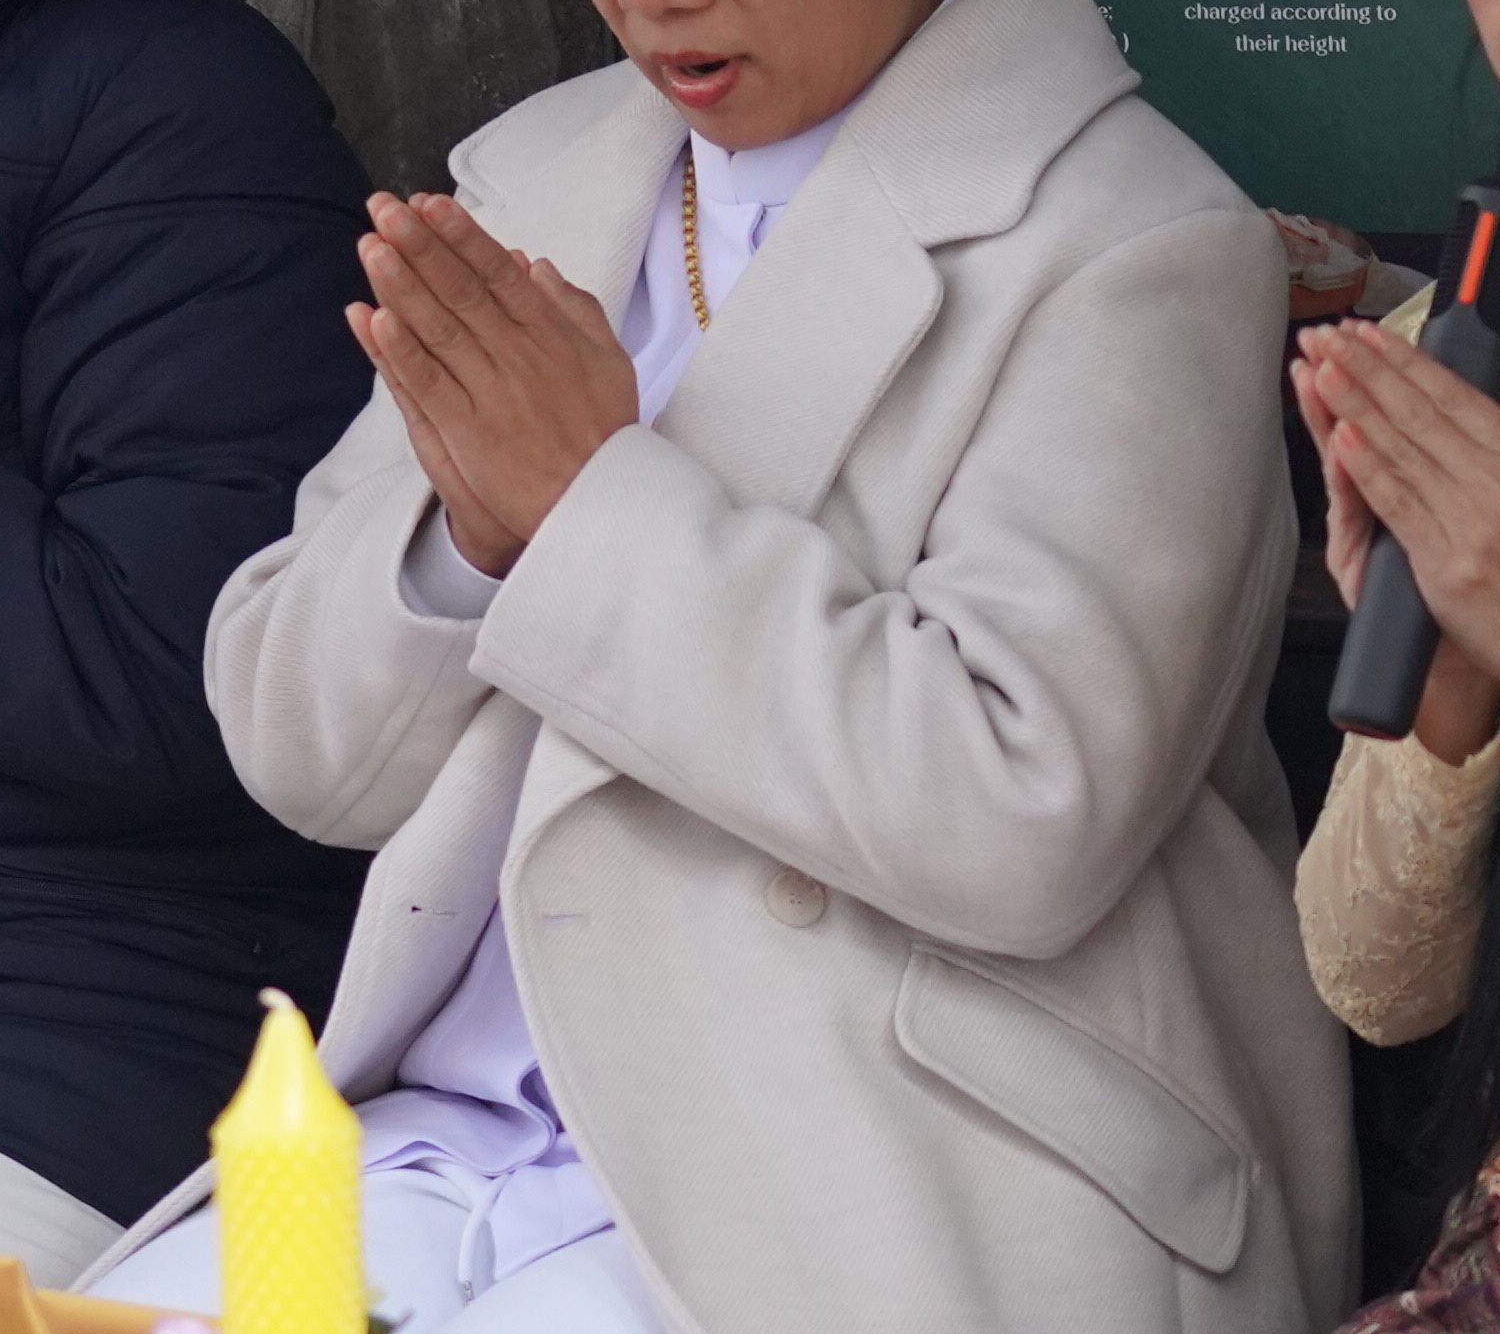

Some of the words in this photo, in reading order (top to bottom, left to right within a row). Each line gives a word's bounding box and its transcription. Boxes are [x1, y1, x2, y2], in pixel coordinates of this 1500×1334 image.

[1184, 2, 1265, 24] charged
[1270, 3, 1371, 25] according
[1376, 4, 1397, 21] to
[1235, 34, 1279, 52] their
[1285, 34, 1348, 57] height
